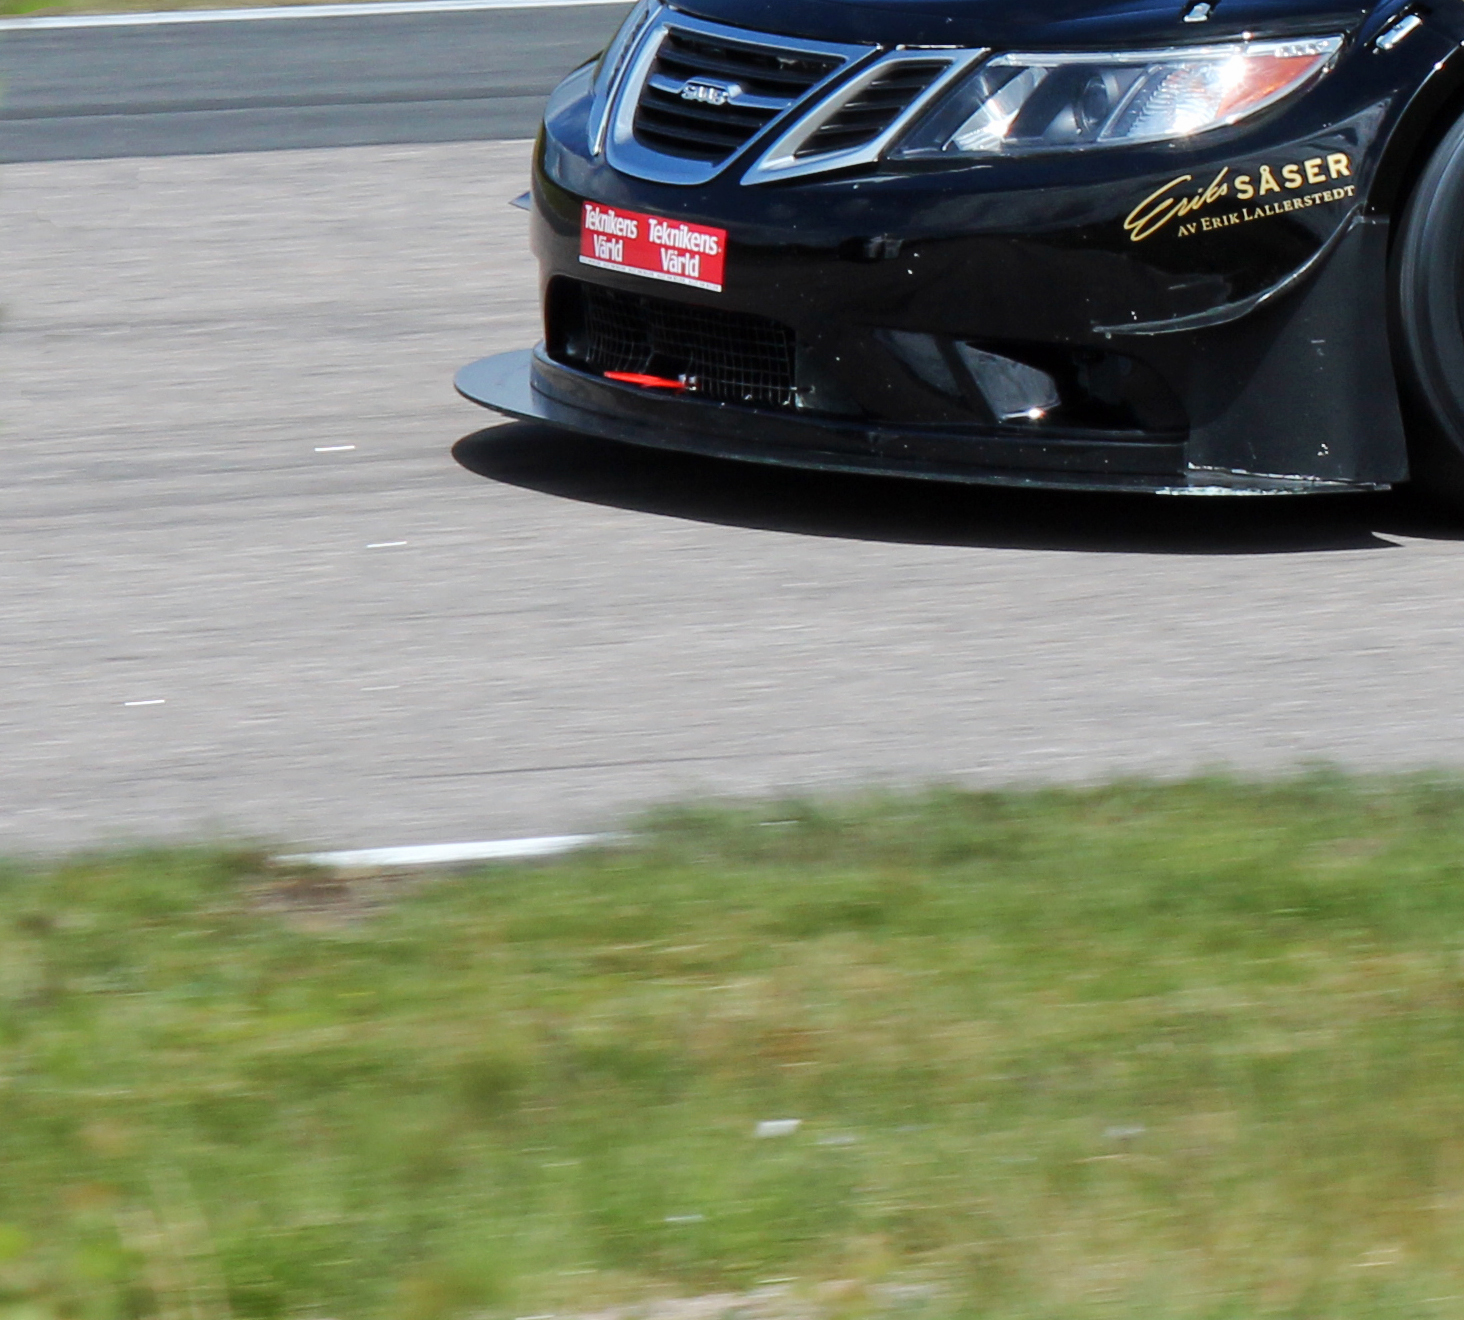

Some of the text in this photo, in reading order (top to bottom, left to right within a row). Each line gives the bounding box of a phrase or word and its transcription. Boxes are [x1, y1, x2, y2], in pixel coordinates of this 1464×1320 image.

[1123, 152, 1351, 242] Eriks SÅSER
[585, 204, 638, 239] Teknikens
[649, 218, 718, 255] Teknikens
[593, 234, 624, 262] Värld
[660, 247, 700, 278] Värld
